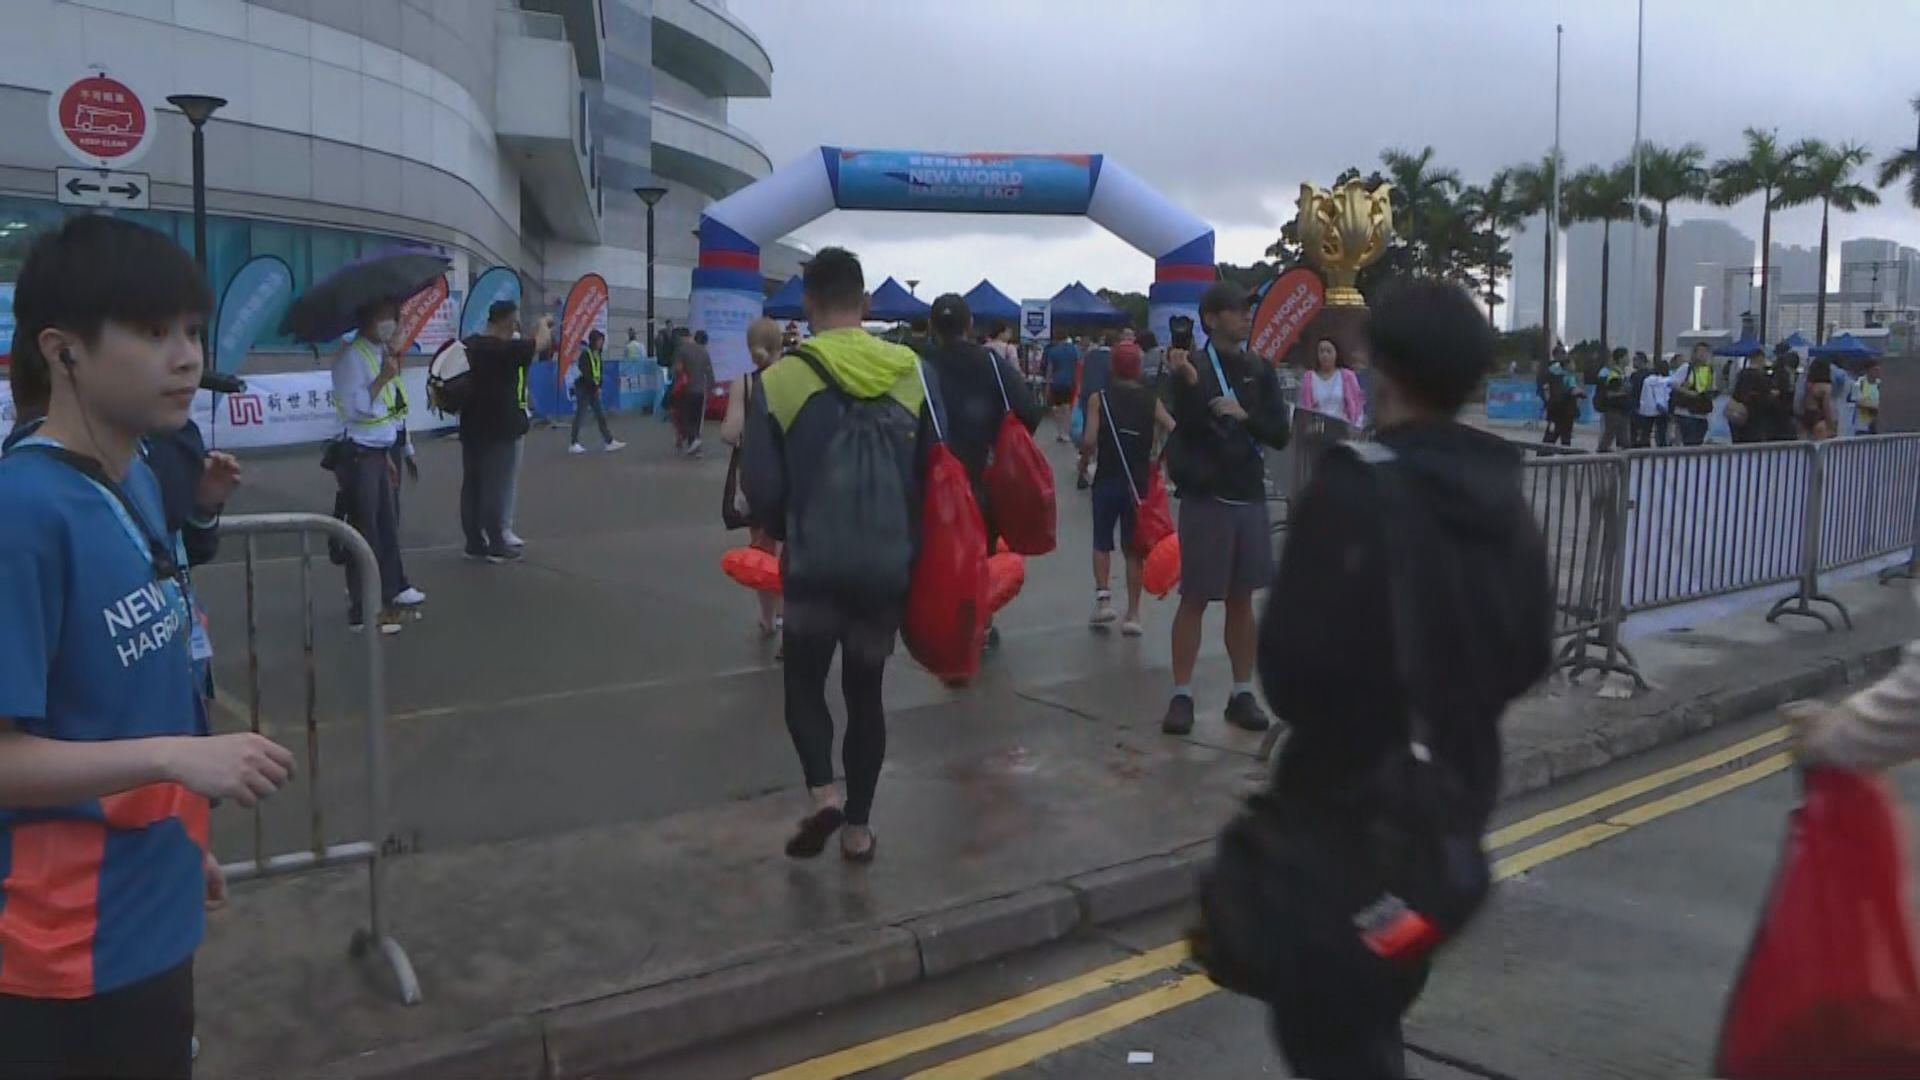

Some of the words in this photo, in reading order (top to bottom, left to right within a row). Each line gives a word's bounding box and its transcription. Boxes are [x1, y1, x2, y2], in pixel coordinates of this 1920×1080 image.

[909, 169, 951, 184] NEW
[955, 170, 1022, 186] WORLD
[983, 186, 1022, 199] RACE
[1252, 322, 1273, 354] NEW
[1271, 283, 1308, 325] WORLD
[1289, 292, 1319, 324] RACE
[103, 581, 167, 637] NEW
[116, 608, 179, 668] HARBO
